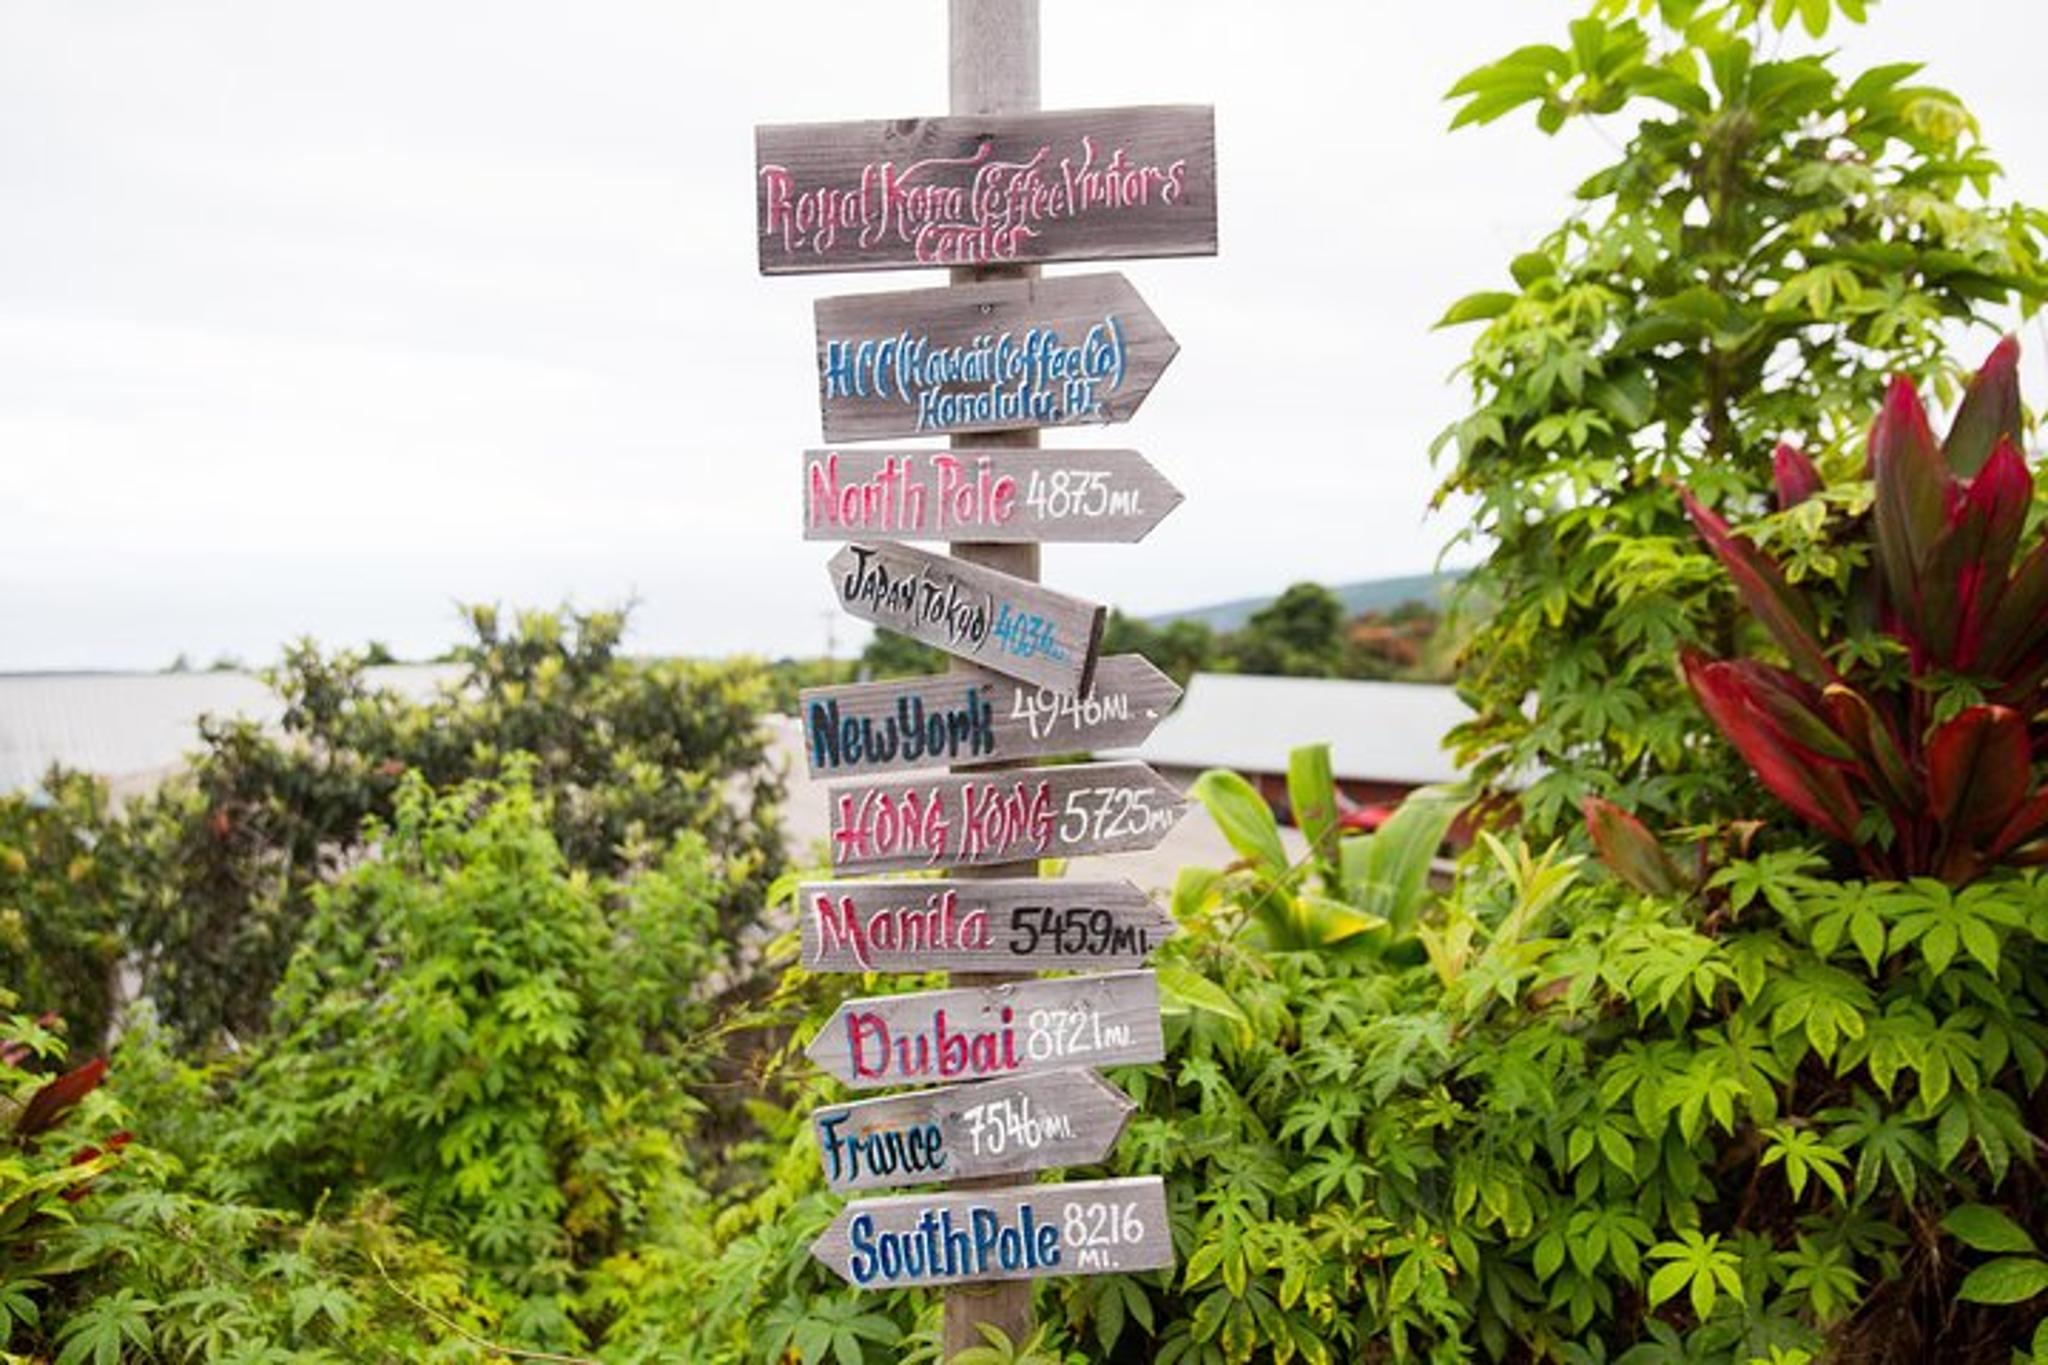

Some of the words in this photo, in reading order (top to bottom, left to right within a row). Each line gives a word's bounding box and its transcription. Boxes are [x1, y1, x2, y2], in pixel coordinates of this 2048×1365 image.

[760, 164, 876, 254] Royal
[872, 143, 991, 243] Kona
[972, 146, 1064, 229] Coffee
[915, 221, 1041, 264] Center
[809, 452, 925, 535] North
[834, 787, 950, 865] HONG
[957, 780, 1058, 864] KONG
[814, 889, 996, 970] Manila
[846, 1006, 1020, 1079] Dubai
[819, 1110, 949, 1182] France
[1063, 1201, 1145, 1248] 8216
